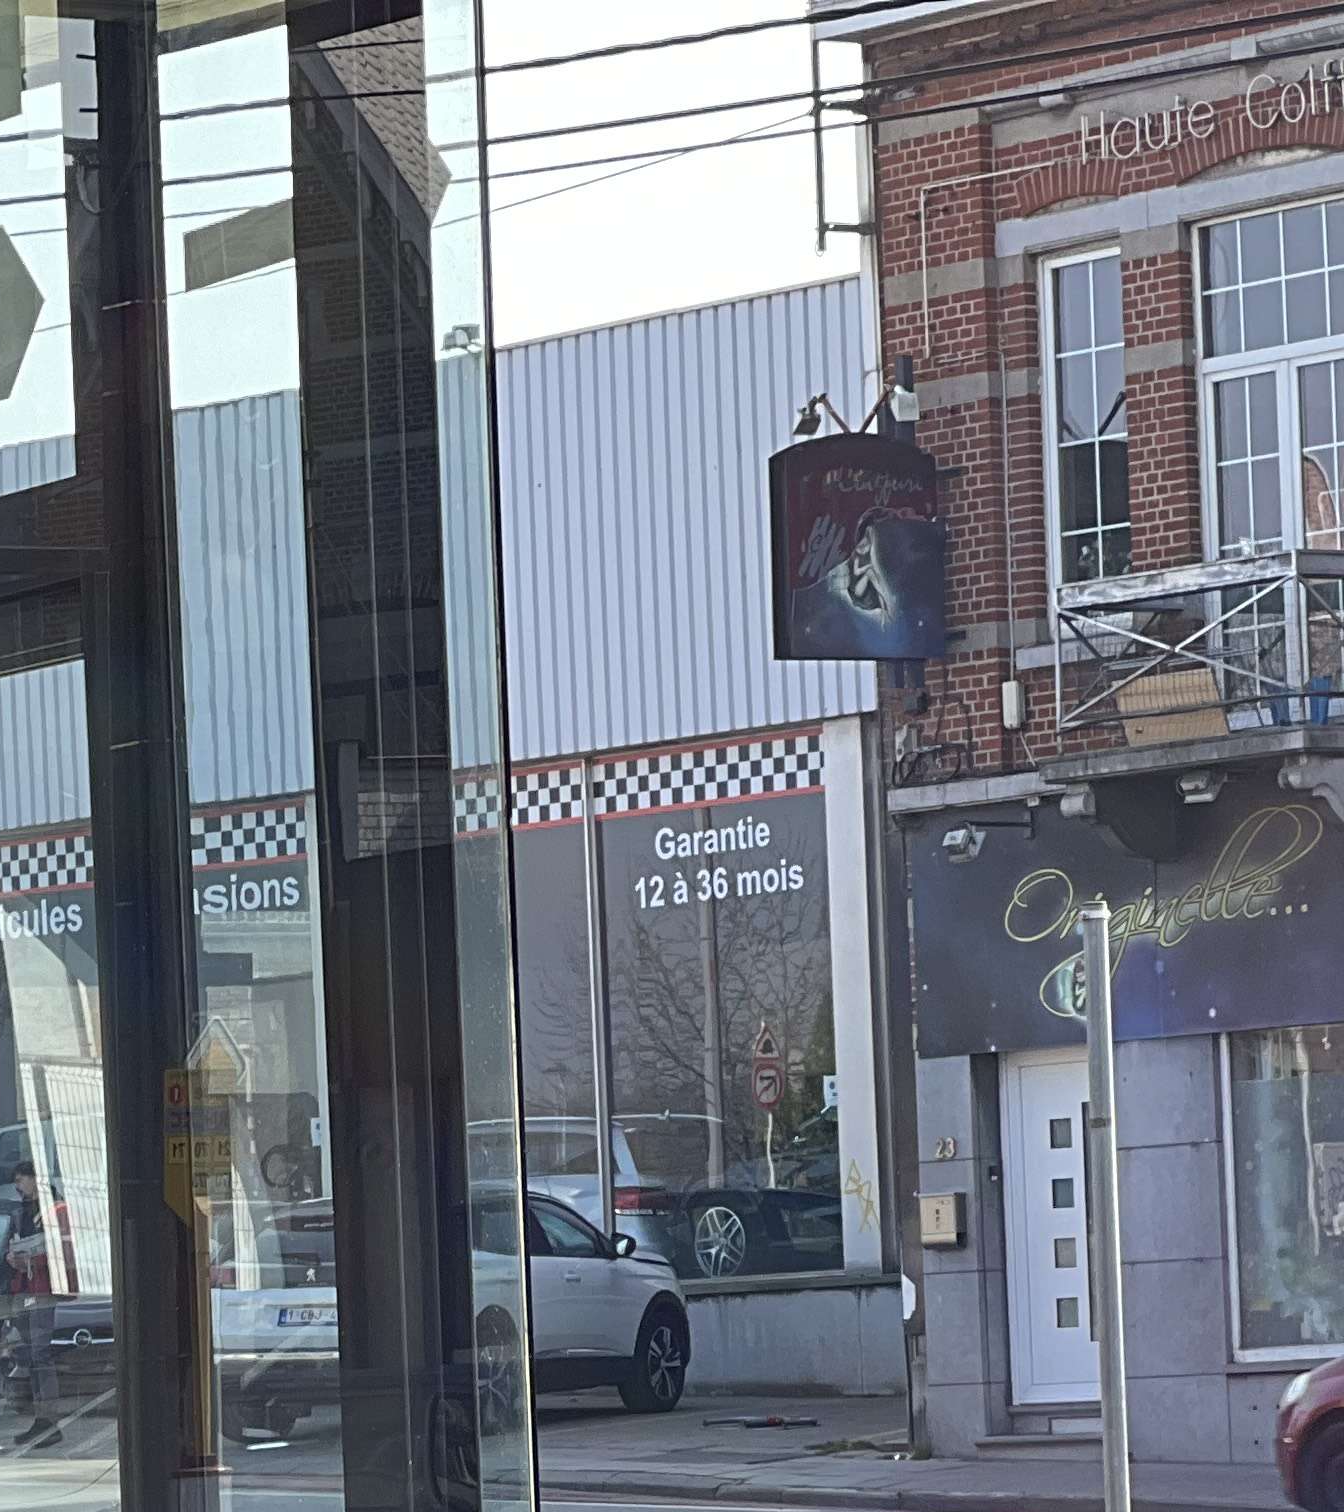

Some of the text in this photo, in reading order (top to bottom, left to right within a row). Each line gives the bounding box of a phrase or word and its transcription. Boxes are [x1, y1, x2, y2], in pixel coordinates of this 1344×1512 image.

[1081, 94, 1215, 165] Haute
[654, 815, 771, 860] Garantie
[634, 858, 805, 910] 12 à 36 mois
[935, 1136, 957, 1160] 23
